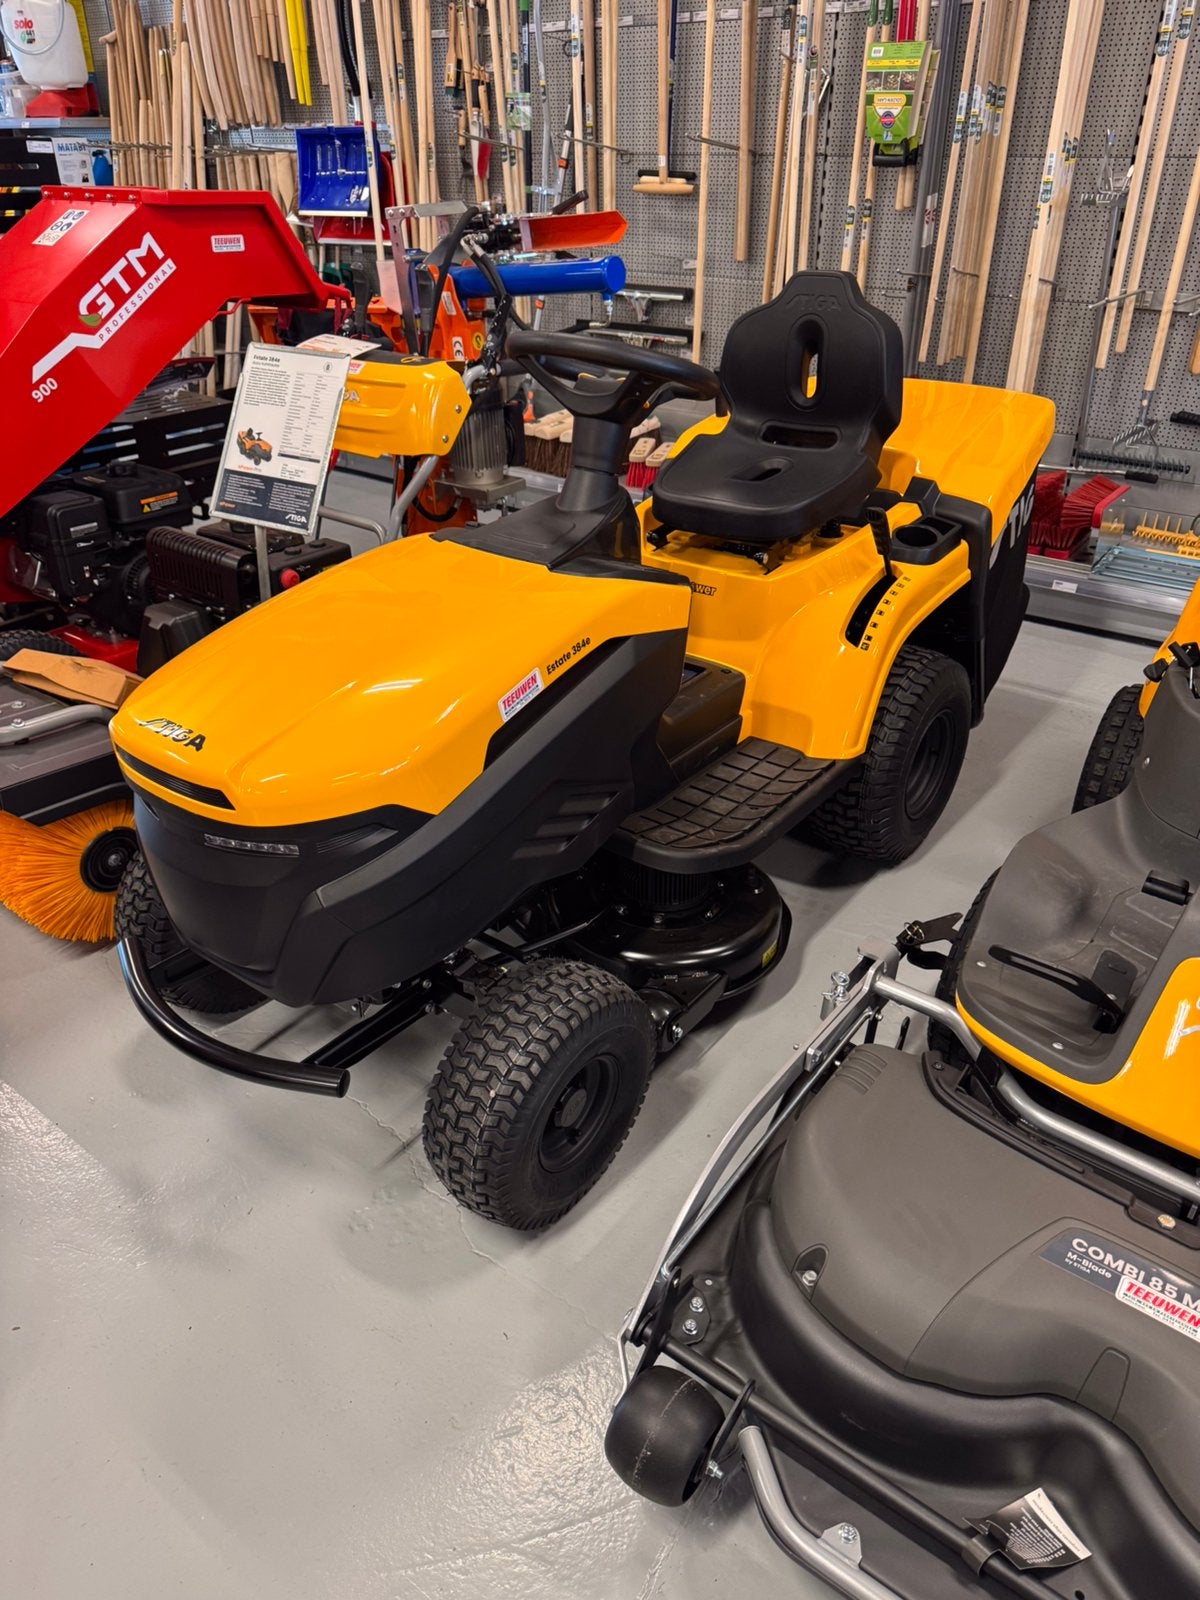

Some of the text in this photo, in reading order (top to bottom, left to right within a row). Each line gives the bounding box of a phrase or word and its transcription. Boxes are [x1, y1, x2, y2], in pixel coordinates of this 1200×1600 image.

[14, 17, 34, 30] solo
[214, 236, 242, 245] TEEUWEN
[79, 232, 165, 320] GTM
[98, 263, 175, 342] PROFESSIONAL
[31, 377, 58, 403] 900
[285, 513, 308, 524] STIGA
[546, 636, 591, 675] Estate 384e
[501, 672, 538, 711] TEEUWEN
[138, 717, 207, 752] STIGA
[1066, 1251, 1112, 1279] M-Blade
[1071, 1237, 1145, 1283] COMBI
[1148, 1275, 1179, 1299] 85
[1124, 1280, 1200, 1329] TEEUWEN
